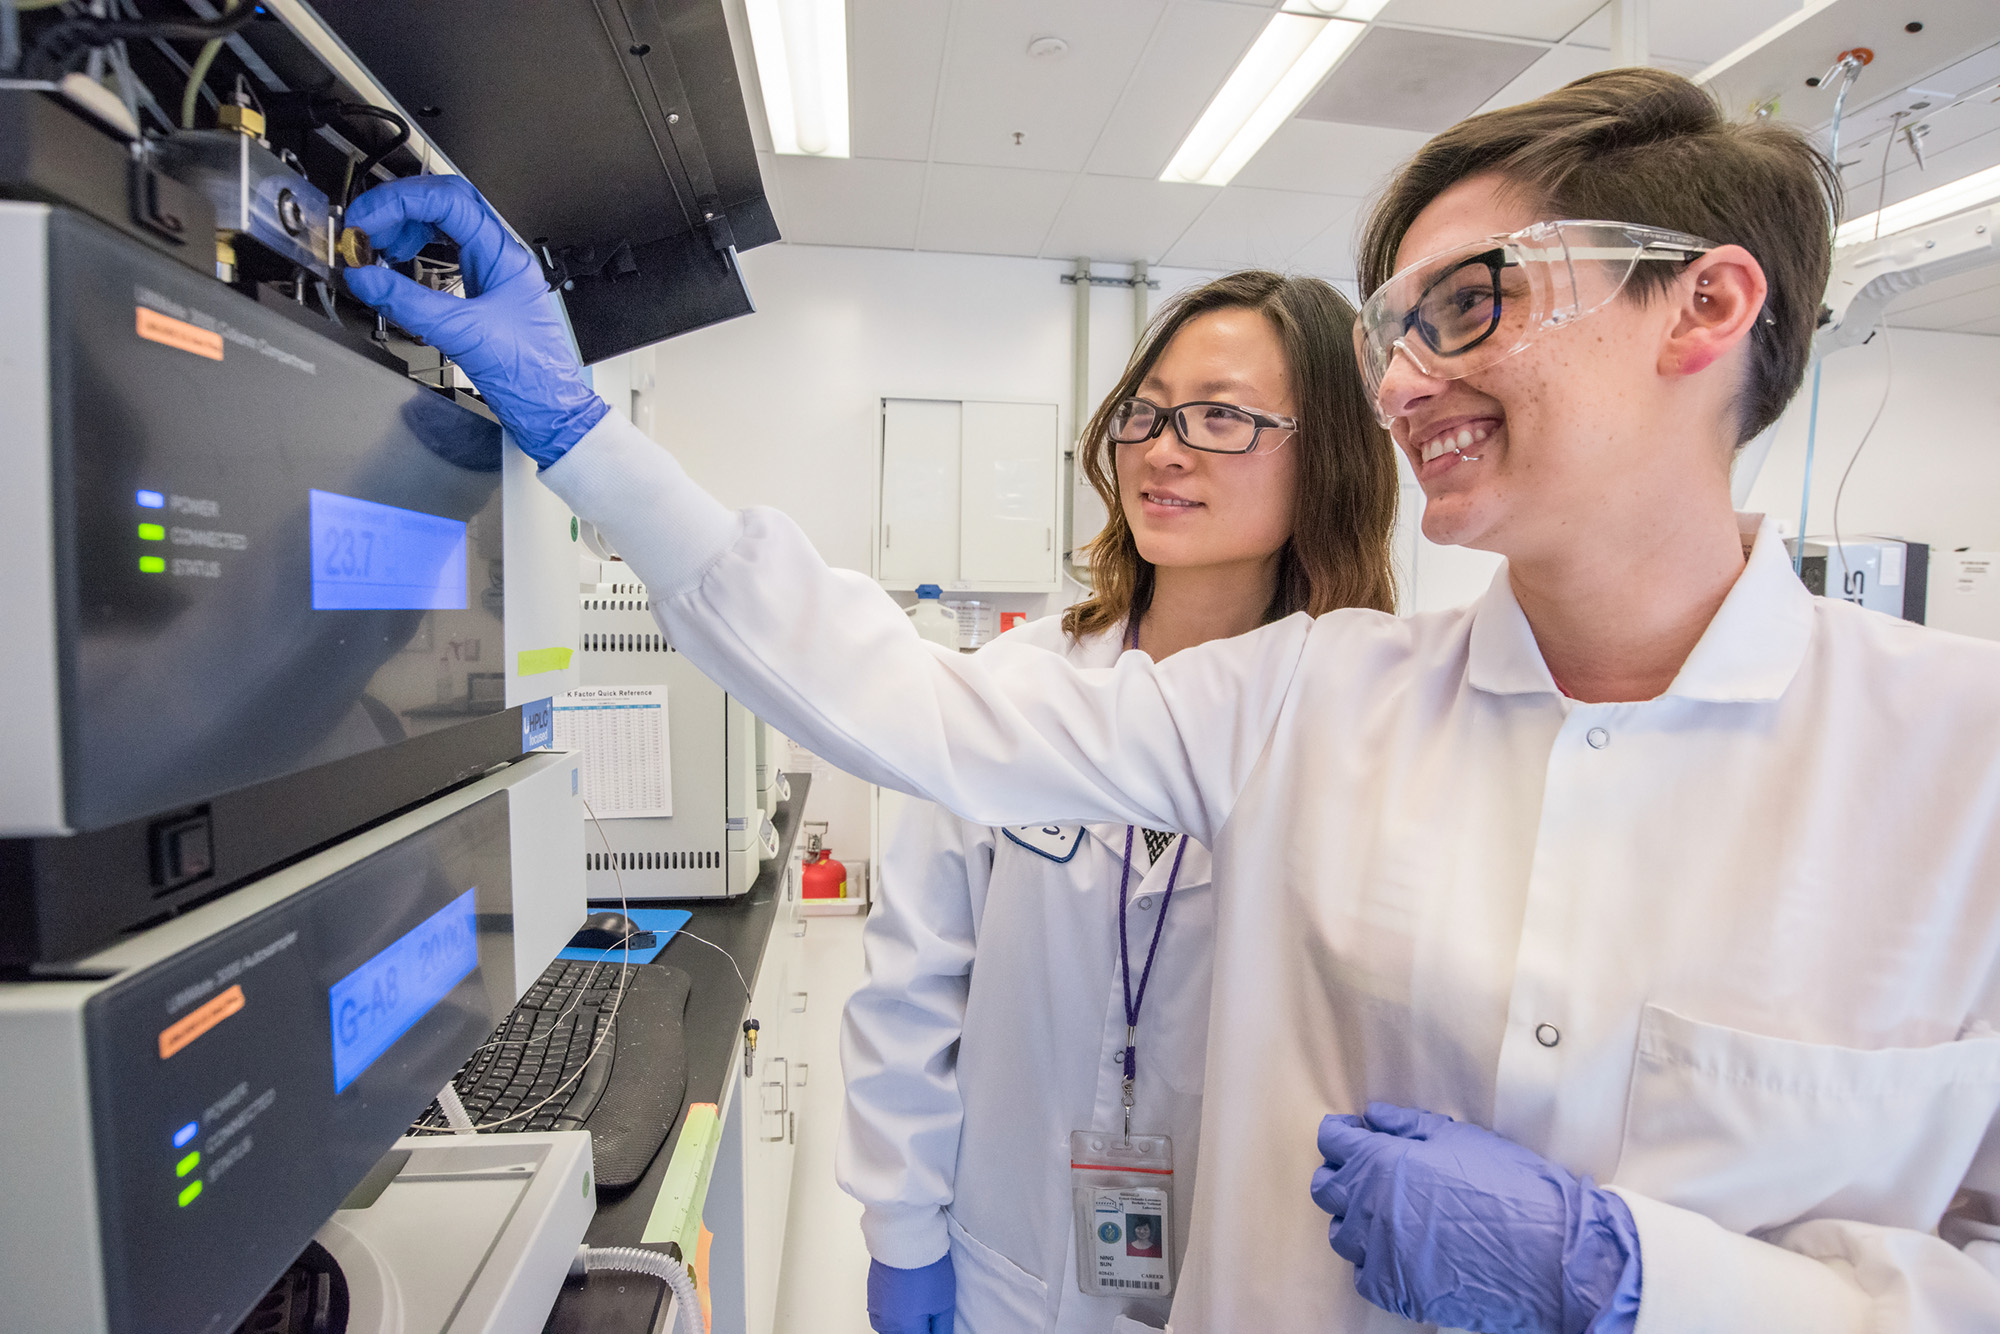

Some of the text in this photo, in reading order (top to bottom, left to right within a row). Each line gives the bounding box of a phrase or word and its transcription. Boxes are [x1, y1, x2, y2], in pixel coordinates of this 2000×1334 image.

[170, 494, 219, 517] POWER
[170, 526, 248, 550] CONNECTED
[325, 527, 375, 577] 23.7
[172, 559, 221, 578] STATUS
[597, 689, 617, 697] Quick
[619, 689, 653, 697] Reference
[529, 728, 549, 746] focused
[338, 965, 400, 1047] G-A8
